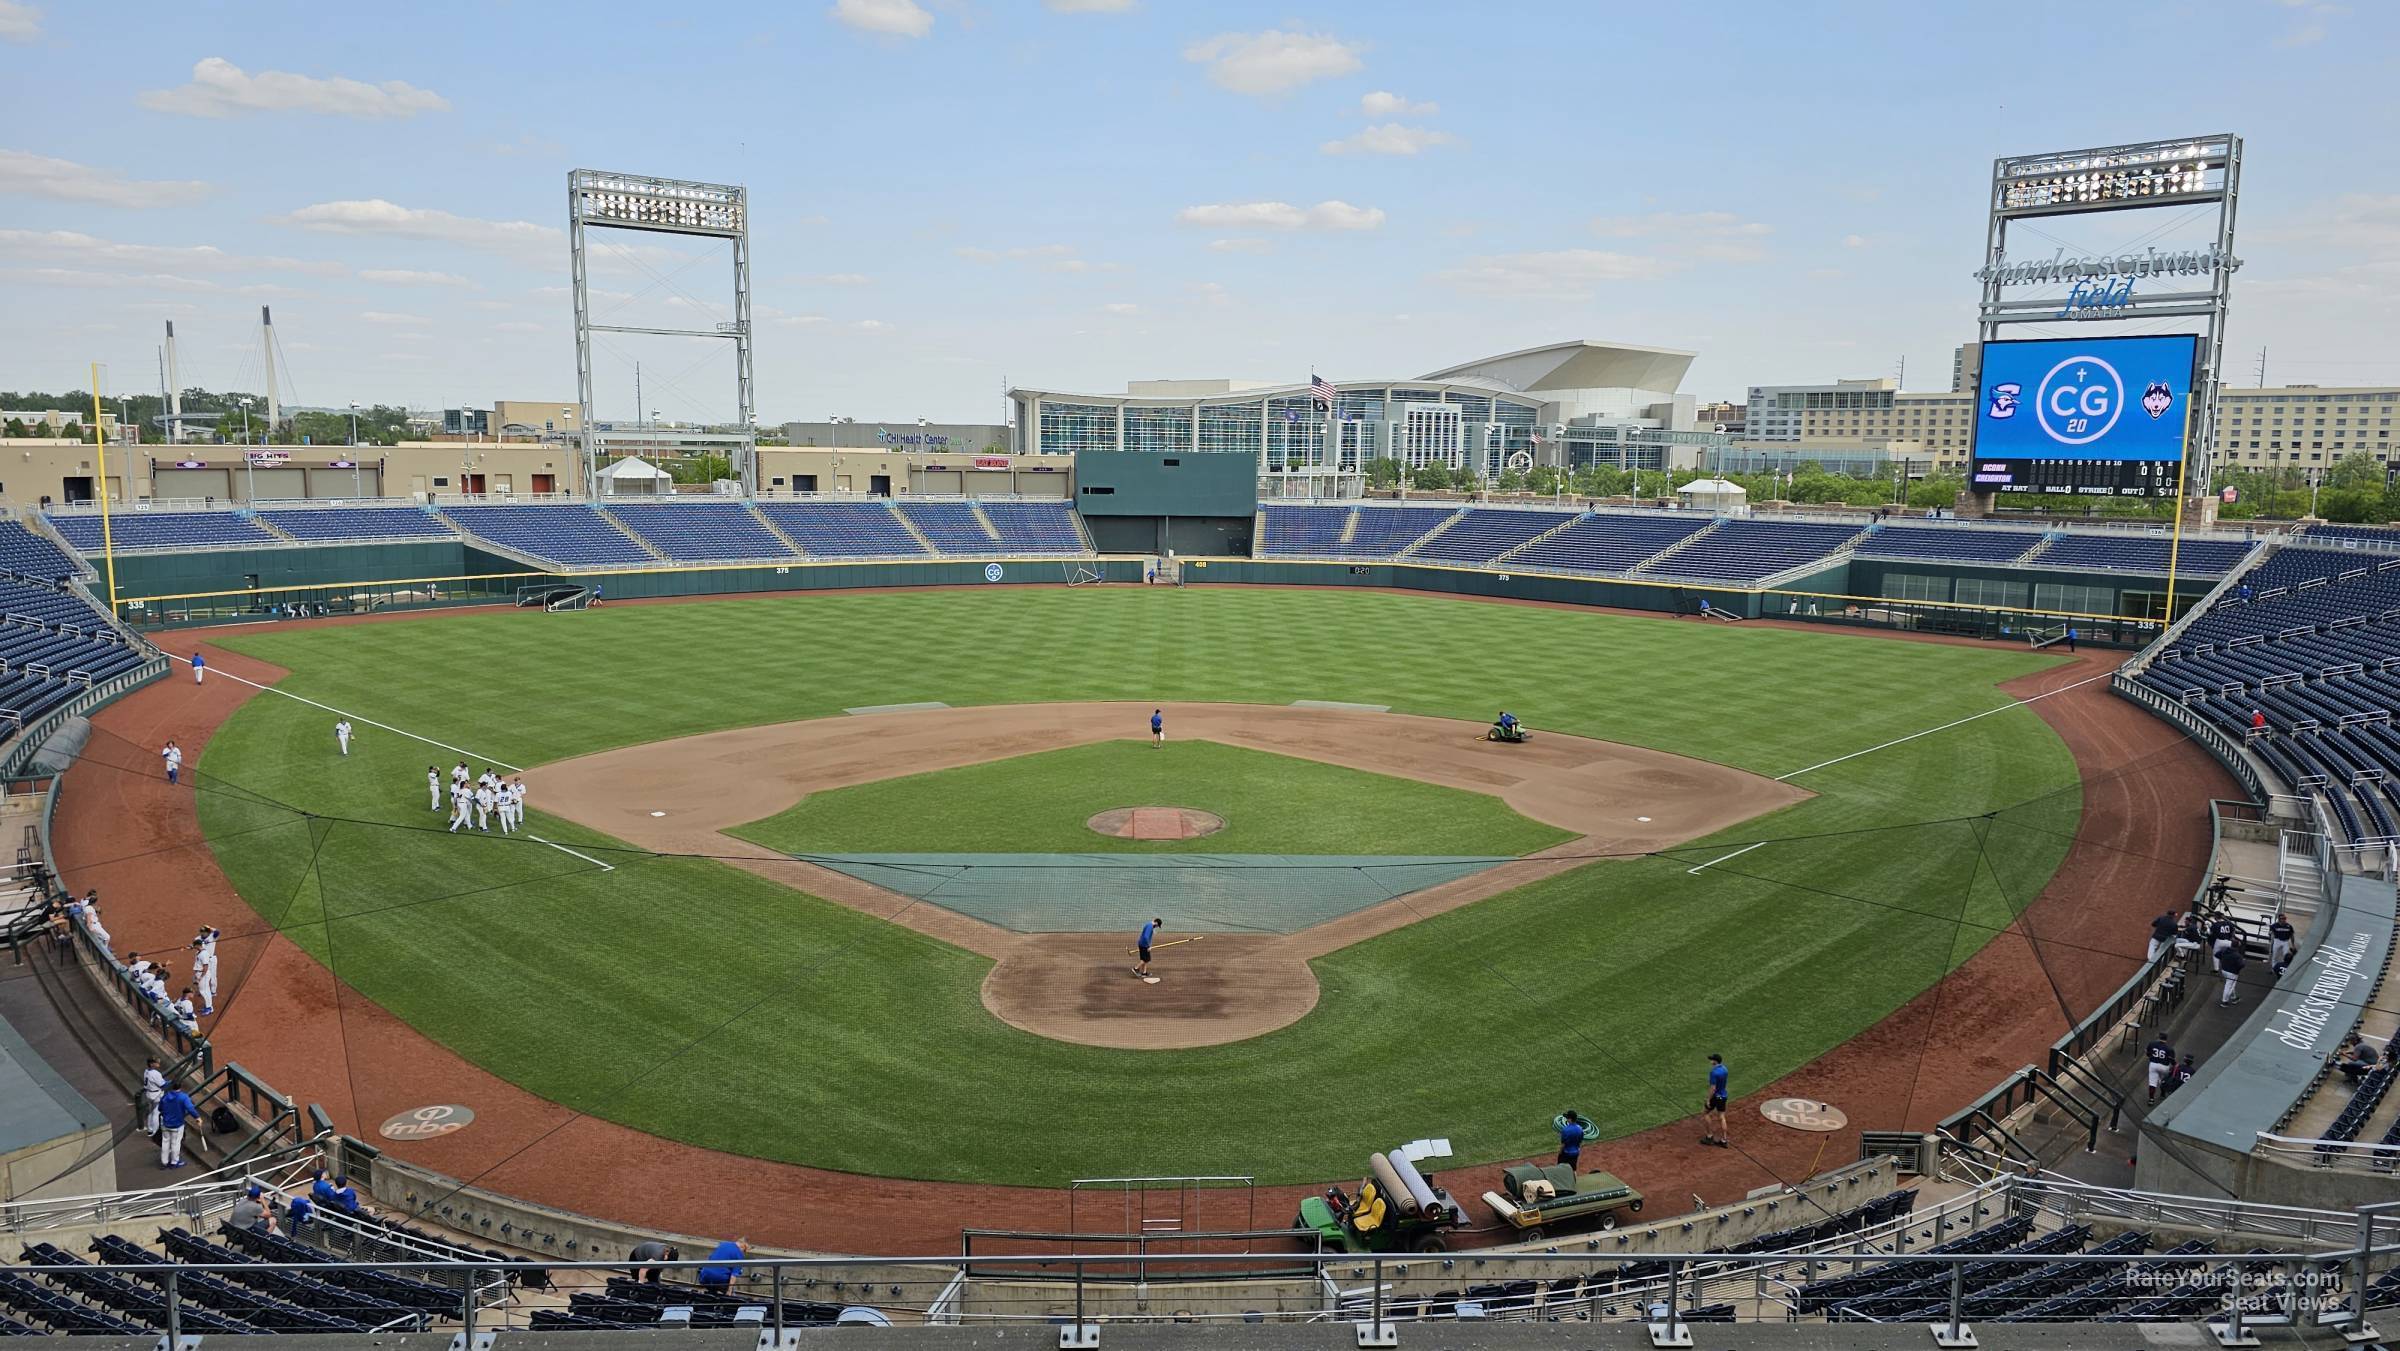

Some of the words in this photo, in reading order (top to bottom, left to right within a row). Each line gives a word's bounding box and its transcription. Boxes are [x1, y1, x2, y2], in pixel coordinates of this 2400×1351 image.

[1976, 247, 2090, 284] charles
[2098, 243, 2227, 281] SCHWAB
[2056, 276, 2136, 318] field
[2069, 308, 2124, 320] OMAHA
[2050, 385, 2109, 417] CG
[2066, 419, 2088, 433] 20
[886, 433, 899, 443] CHI
[925, 433, 948, 444] Center
[2141, 466, 2148, 475] 0
[2156, 466, 2163, 476] 0
[987, 568, 1000, 576] CG
[128, 601, 145, 610] 335
[2137, 621, 2155, 630] 335
[2312, 944, 2369, 980] field
[2305, 969, 2351, 1010] SCHWAB
[2265, 1004, 2331, 1050] charles
[2152, 1048, 2166, 1059] 36
[1766, 1110, 1842, 1129] fnbo
